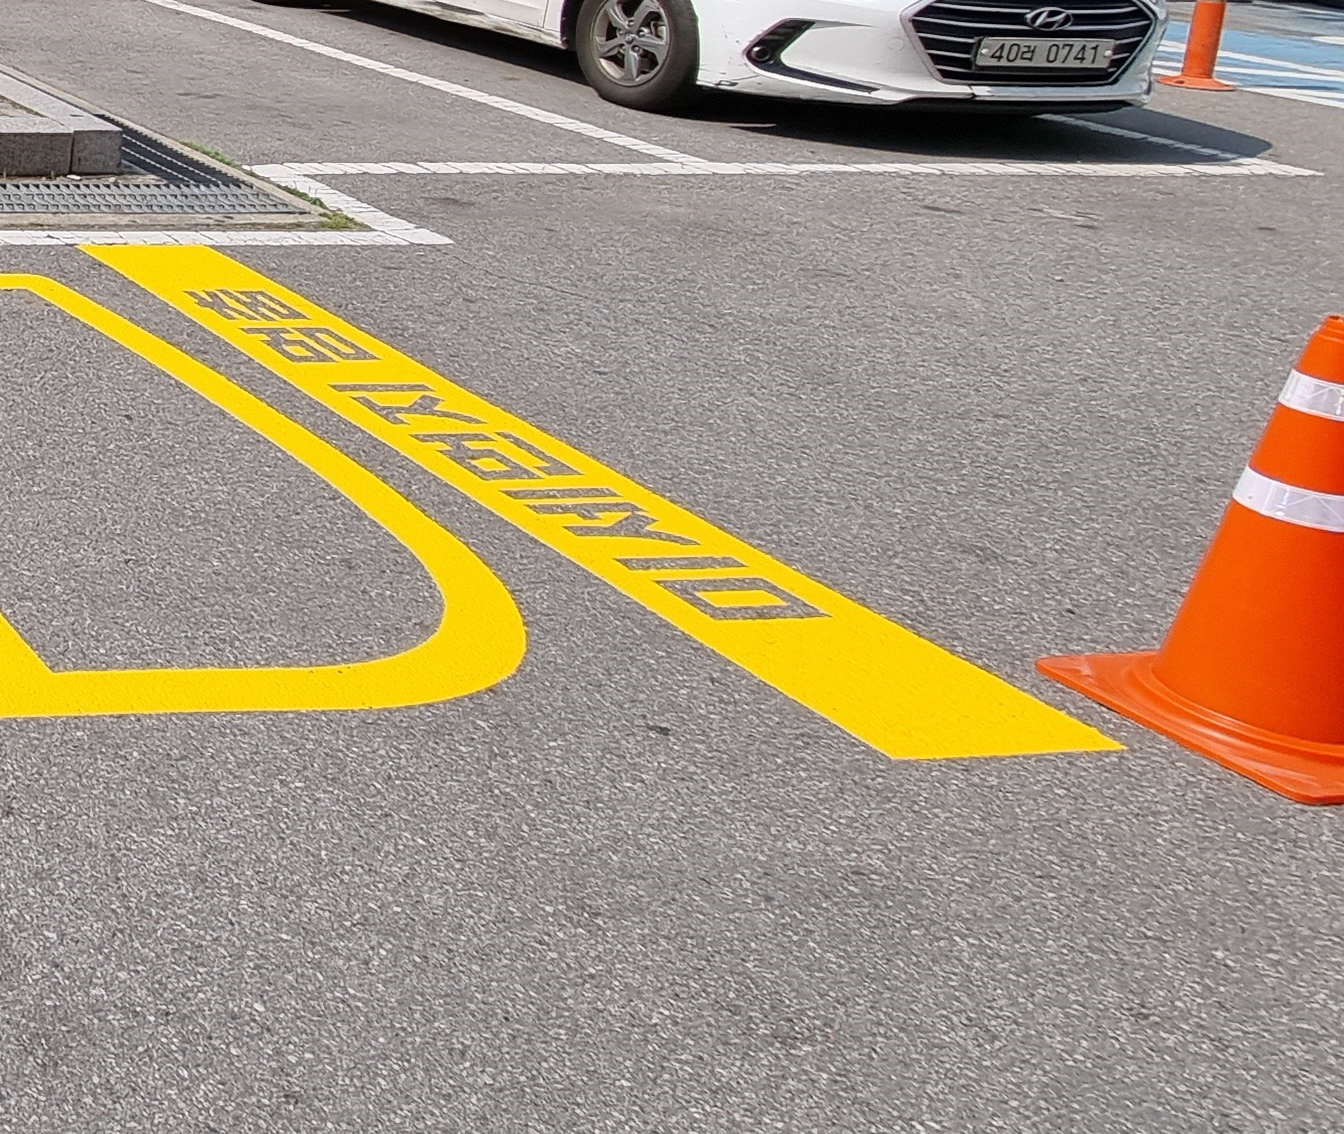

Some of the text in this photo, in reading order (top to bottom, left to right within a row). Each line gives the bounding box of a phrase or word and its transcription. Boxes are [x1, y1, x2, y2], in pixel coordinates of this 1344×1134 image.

[1046, 43, 1100, 64] 0741
[183, 288, 835, 622] 미세먼지 멈춤
